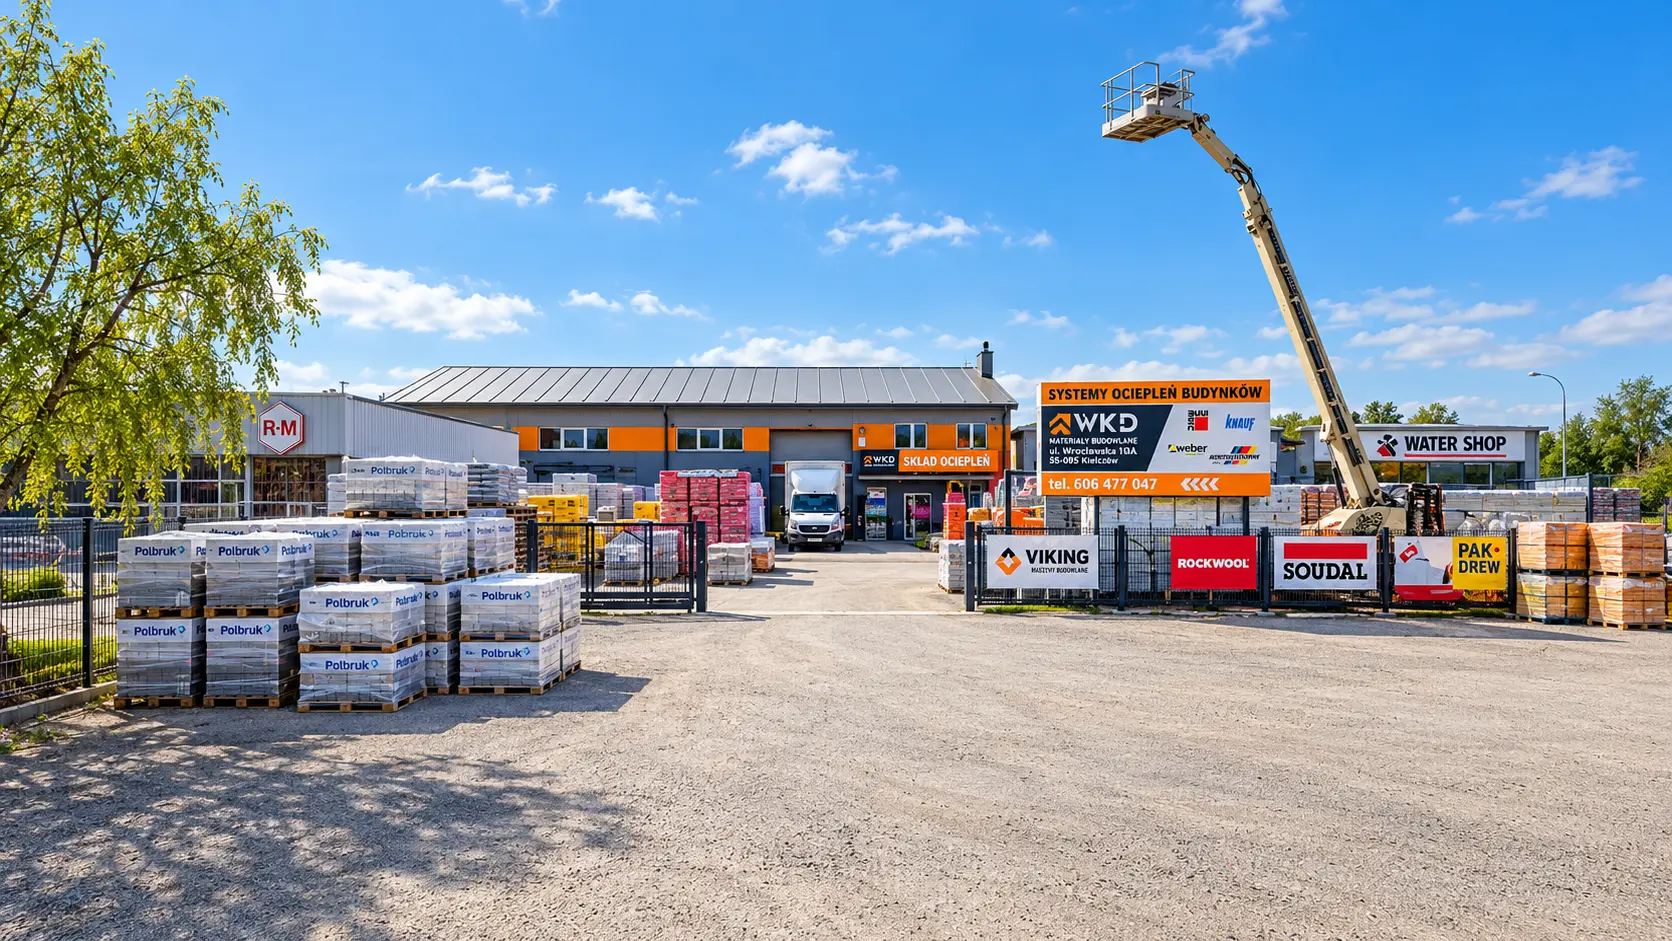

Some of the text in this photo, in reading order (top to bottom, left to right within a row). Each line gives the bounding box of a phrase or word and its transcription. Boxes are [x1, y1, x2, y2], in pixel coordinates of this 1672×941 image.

[1048, 383, 1262, 400] SYSTEMY OCIEPLEŃ BUDYNKÓW
[1074, 413, 1138, 433] WKD
[1176, 444, 1208, 453] weber
[1404, 435, 1507, 452] WATER SHOP
[1049, 446, 1060, 455] ul.
[872, 455, 896, 464] WKD
[940, 453, 991, 467] OCIEPLEŃ
[371, 466, 408, 475] Polbruk
[1048, 477, 1158, 490] tel. 606 477 047
[135, 546, 177, 556] Polbruk
[218, 546, 261, 556] Polbruk
[1458, 543, 1493, 558] PAK
[1025, 549, 1089, 565] VIKING
[1177, 558, 1250, 569] ROCKWOOL
[1458, 560, 1501, 574] DREW
[1283, 562, 1368, 580] SOUDAL
[482, 591, 523, 601] Polbruk
[325, 597, 369, 608] Polbruk
[134, 625, 177, 636] Polbruk
[220, 624, 263, 635] Polbruk
[481, 648, 523, 658] Polbruk
[325, 660, 370, 670] Polbruk
